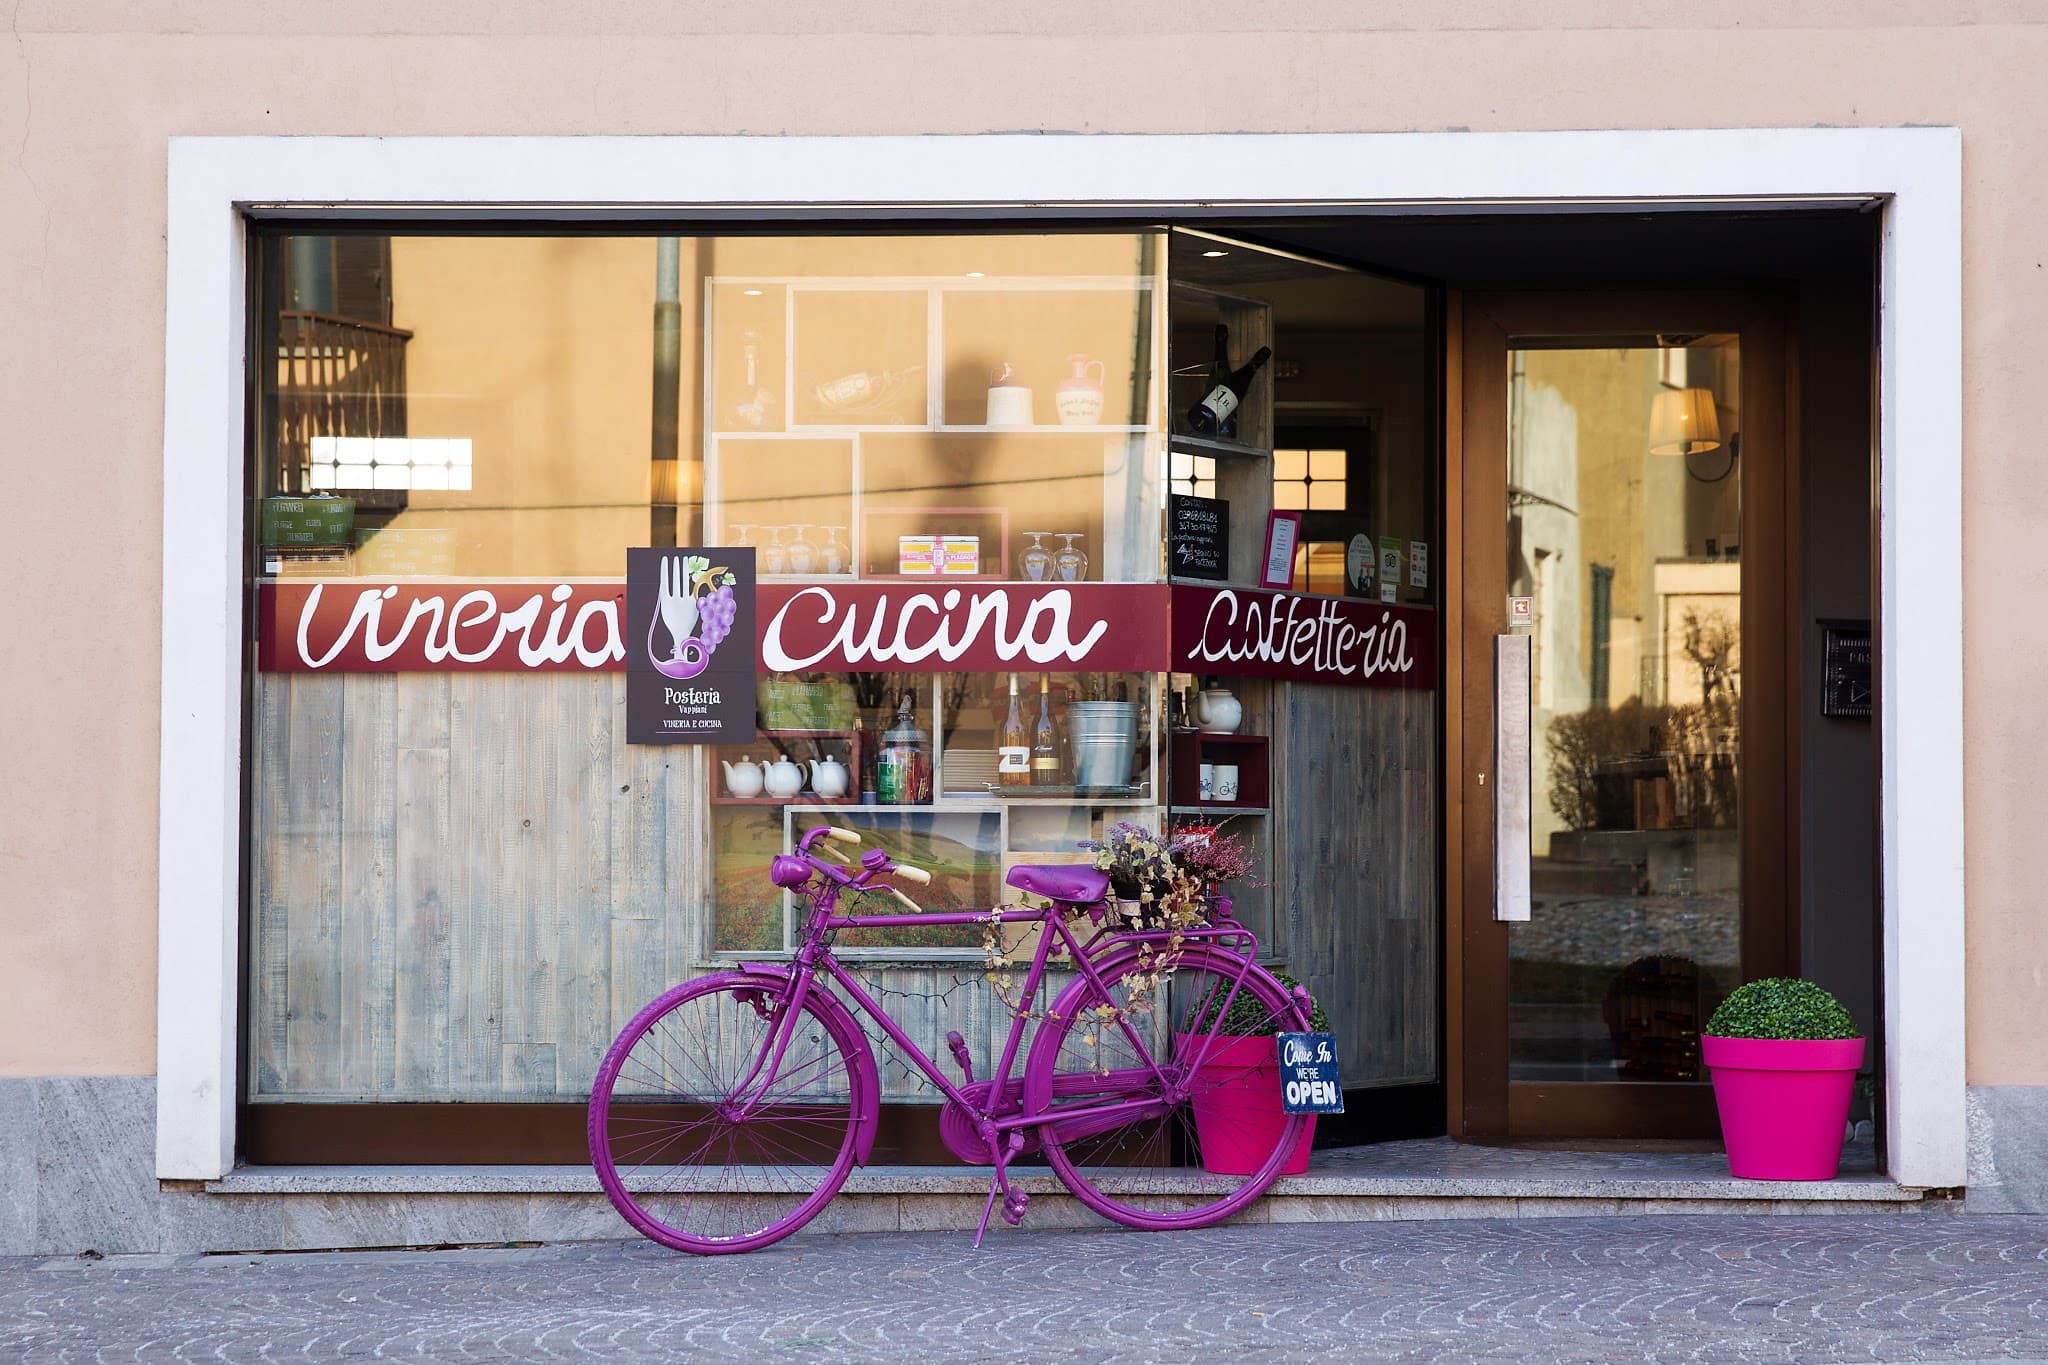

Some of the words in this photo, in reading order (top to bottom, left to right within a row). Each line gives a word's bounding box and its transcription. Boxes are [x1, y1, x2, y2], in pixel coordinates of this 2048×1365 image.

[296, 584, 626, 669] Vineria
[762, 587, 1108, 672] Cucina
[1188, 589, 1414, 678] Caffetteria
[664, 687, 721, 705] Posteria
[663, 719, 691, 729] VINERIA
[692, 719, 698, 729] E
[698, 719, 722, 729] CUCINA
[1316, 1041, 1333, 1063] In
[1296, 1067, 1320, 1079] WE'RE
[1286, 1080, 1336, 1105] OPEN
